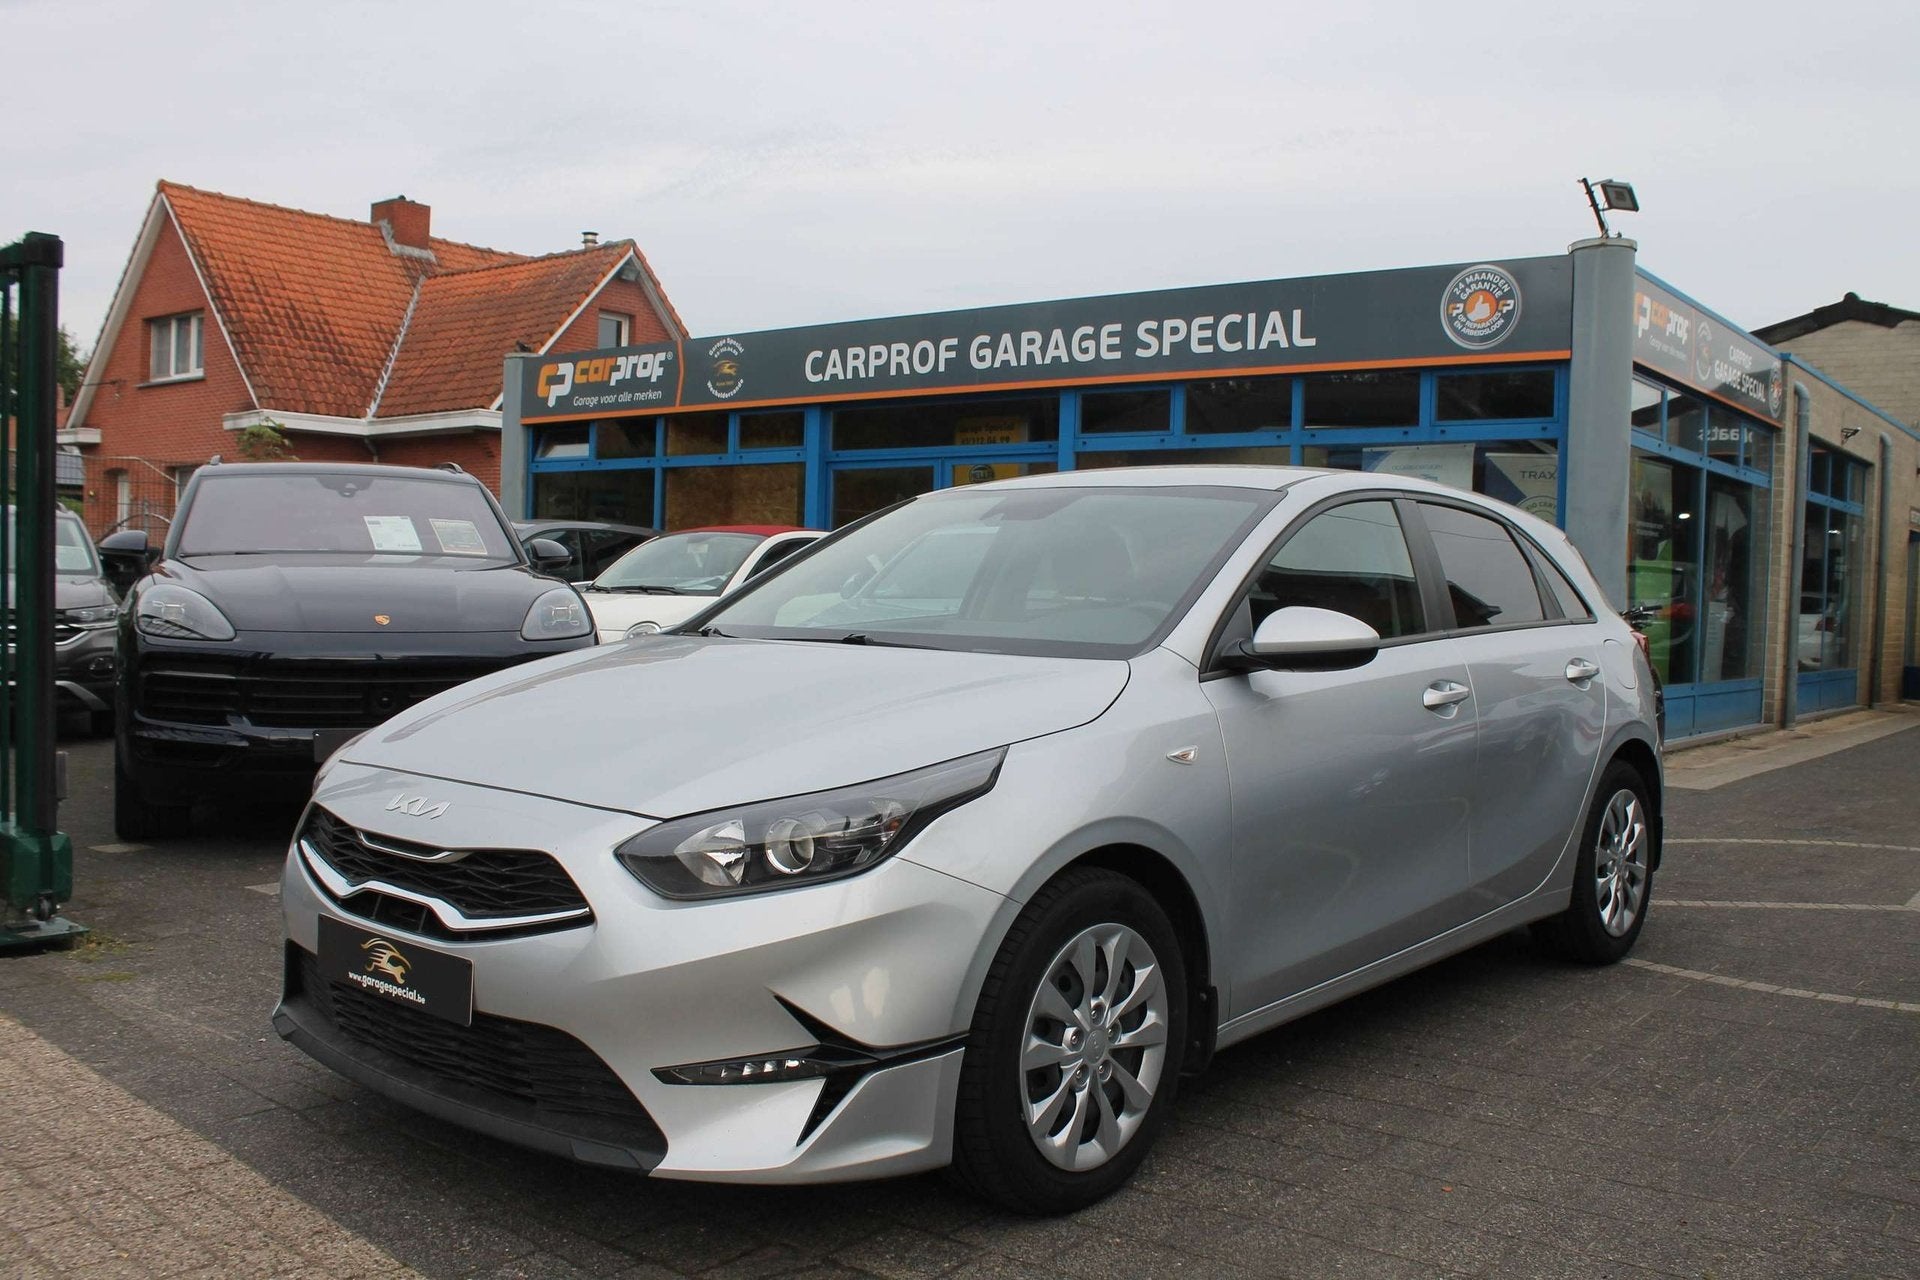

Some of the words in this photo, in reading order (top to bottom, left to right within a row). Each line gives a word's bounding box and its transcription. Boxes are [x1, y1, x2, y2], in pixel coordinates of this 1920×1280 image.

[1453, 282, 1465, 295] 24
[1465, 272, 1511, 293] MAANDEN
[1460, 281, 1503, 300] GARANTIE
[804, 337, 959, 383] CARPROF
[969, 323, 1122, 370] GARAGE
[1135, 308, 1317, 358] SPECIAL
[574, 352, 666, 386] carprof
[573, 396, 599, 408] Garage
[600, 394, 617, 404] voor
[618, 391, 633, 402] alle
[633, 389, 662, 402] merken
[1741, 373, 1765, 403] SPECIAL
[348, 971, 426, 1005] www.garagespecial.be
